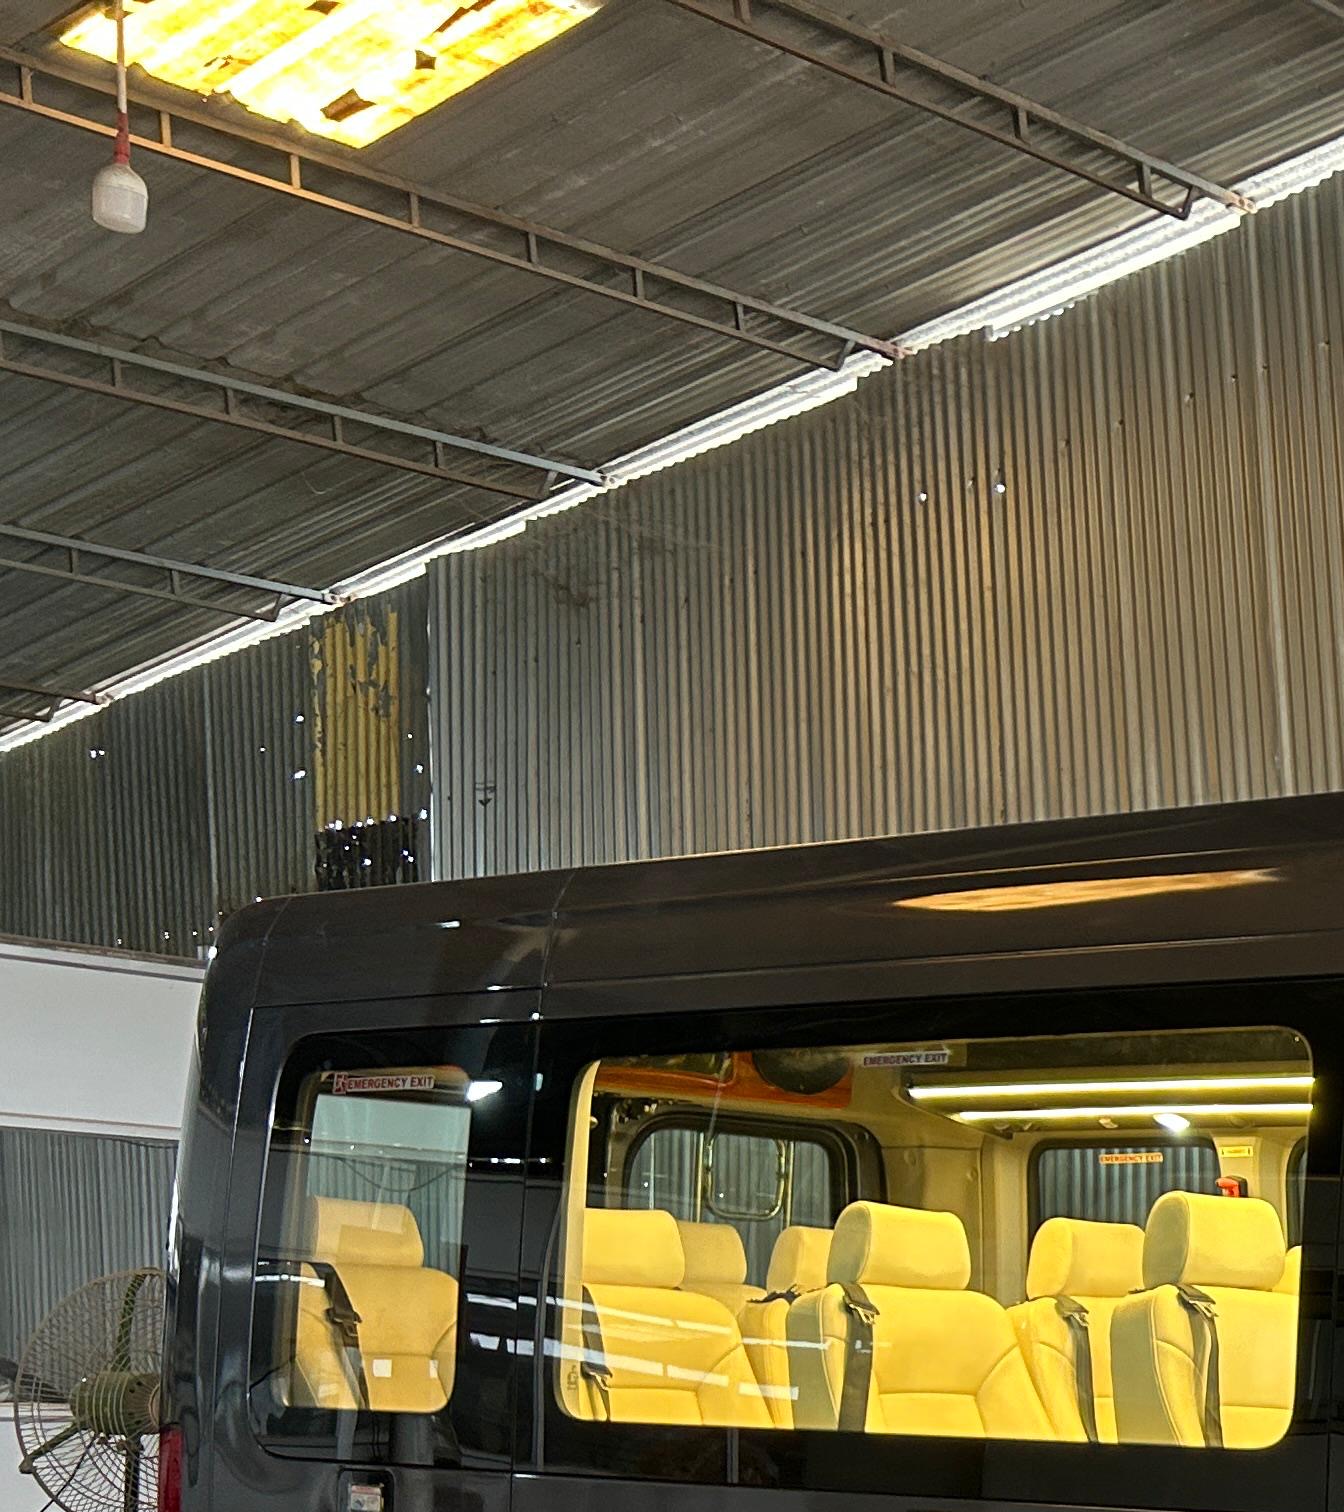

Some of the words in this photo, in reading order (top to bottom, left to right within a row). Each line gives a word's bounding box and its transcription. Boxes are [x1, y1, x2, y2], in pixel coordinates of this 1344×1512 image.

[864, 1054, 922, 1066] EMERGENCY
[924, 1053, 947, 1063] EXIT
[348, 1077, 407, 1090] EMERGENCY
[410, 1076, 433, 1089] EXIT
